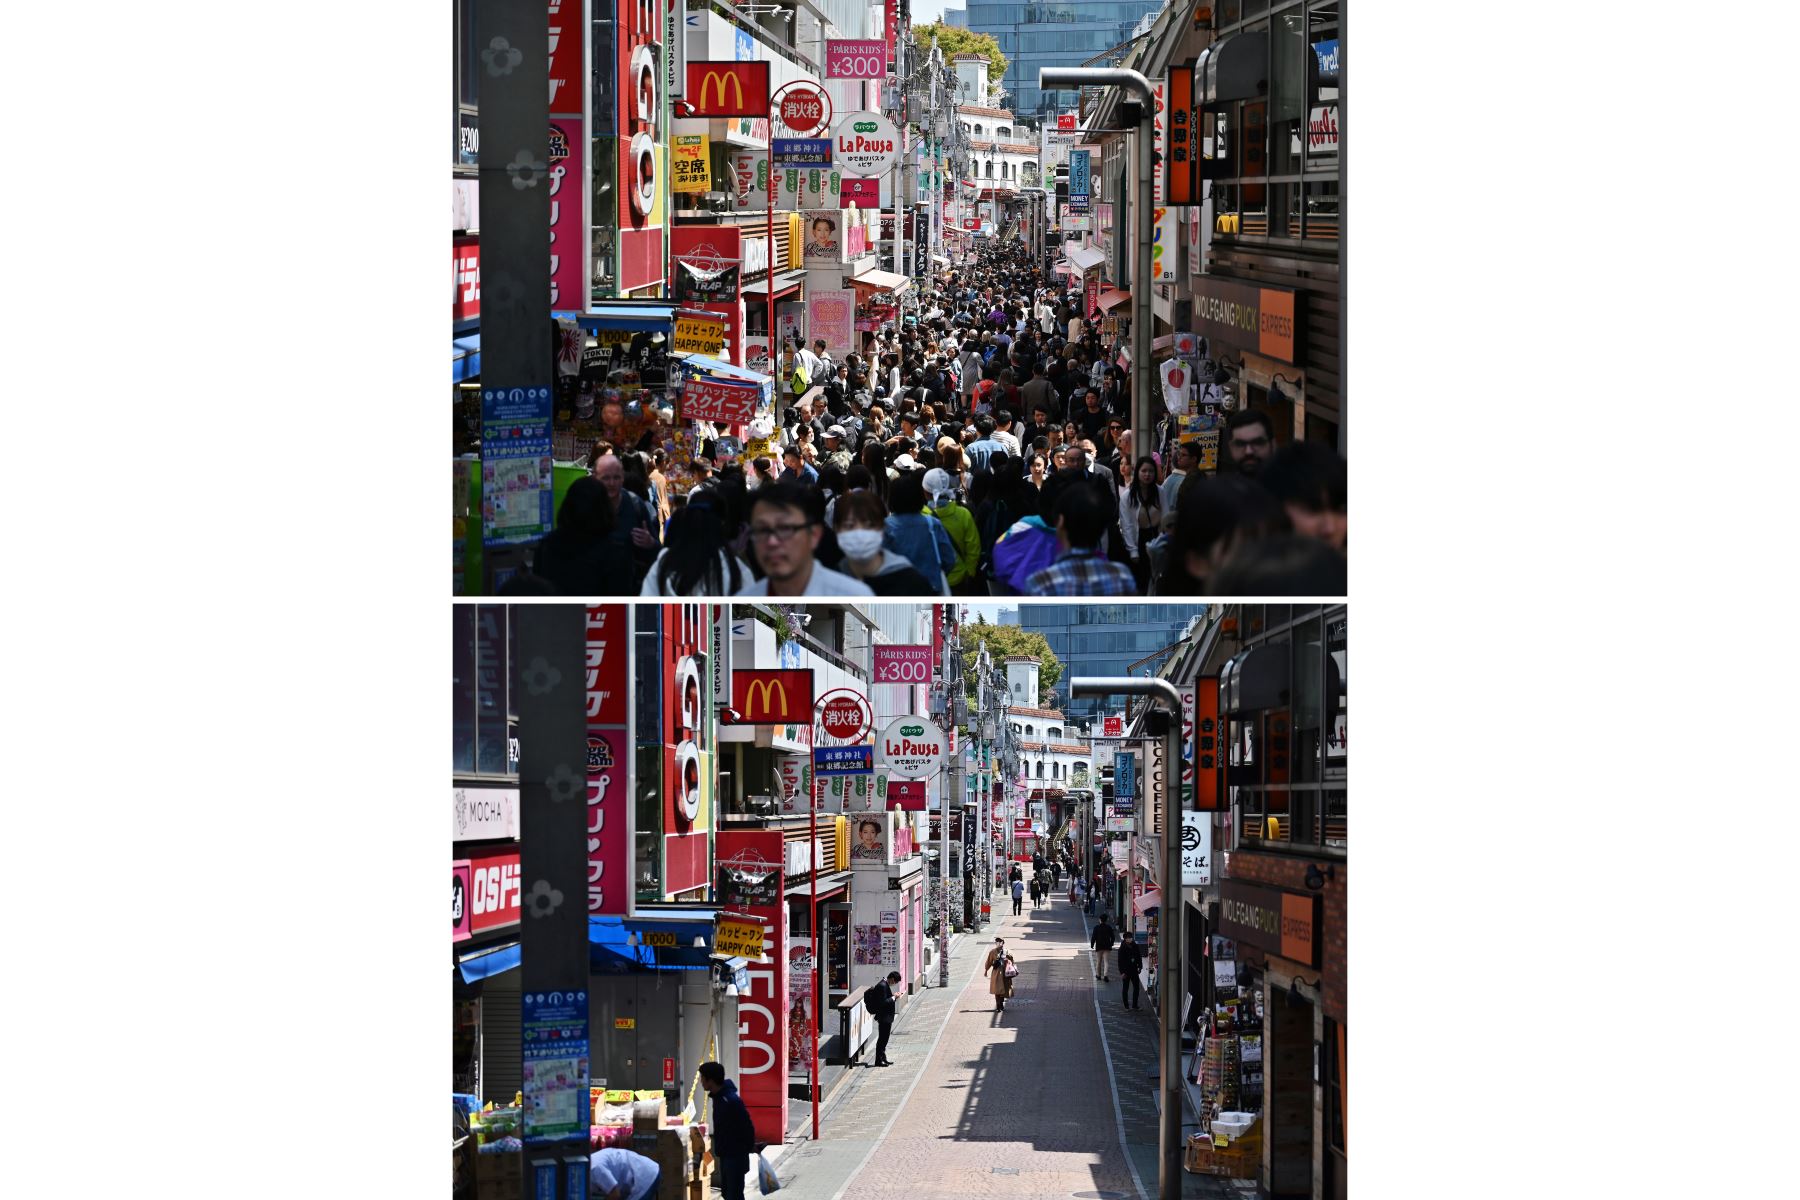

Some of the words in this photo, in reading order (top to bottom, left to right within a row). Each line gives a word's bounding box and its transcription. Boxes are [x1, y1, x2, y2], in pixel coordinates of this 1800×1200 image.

[833, 45, 857, 55] PARIS
[858, 45, 881, 55] KID'S
[831, 56, 881, 76] ¥300
[784, 101, 820, 119] 消火栓
[784, 143, 822, 153] 東郷神社
[839, 135, 853, 153] La
[855, 135, 893, 155] Pausa
[674, 159, 705, 175] 空席
[737, 155, 753, 170] La
[678, 174, 709, 183] あります!
[1163, 271, 1173, 279] B1
[694, 281, 722, 291] TRAP
[677, 322, 723, 338] ハッピーワン
[1261, 312, 1292, 339] EXPRESS
[585, 349, 612, 358] TOKYO
[675, 338, 702, 352] HAPPY
[702, 341, 721, 354] ONE
[684, 392, 757, 416] スクイーズ
[682, 406, 751, 423] SQUEEZE
[880, 650, 904, 659] PARIS
[905, 650, 927, 659] KID'S
[879, 661, 927, 681] ¥300
[825, 709, 861, 726] 消火栓
[825, 751, 861, 761] 東郷神社
[886, 739, 901, 756] La
[902, 739, 939, 757] Pausa
[783, 761, 798, 778] La
[826, 761, 864, 771] 東郷記念館
[469, 801, 502, 822] MOCHA
[473, 863, 520, 915] OSドラ
[739, 885, 765, 895] TRAP
[719, 925, 763, 941] ハッピーワン
[1282, 916, 1311, 944] EXPRESS
[716, 940, 744, 954] HAPPY
[744, 944, 762, 957] ONE
